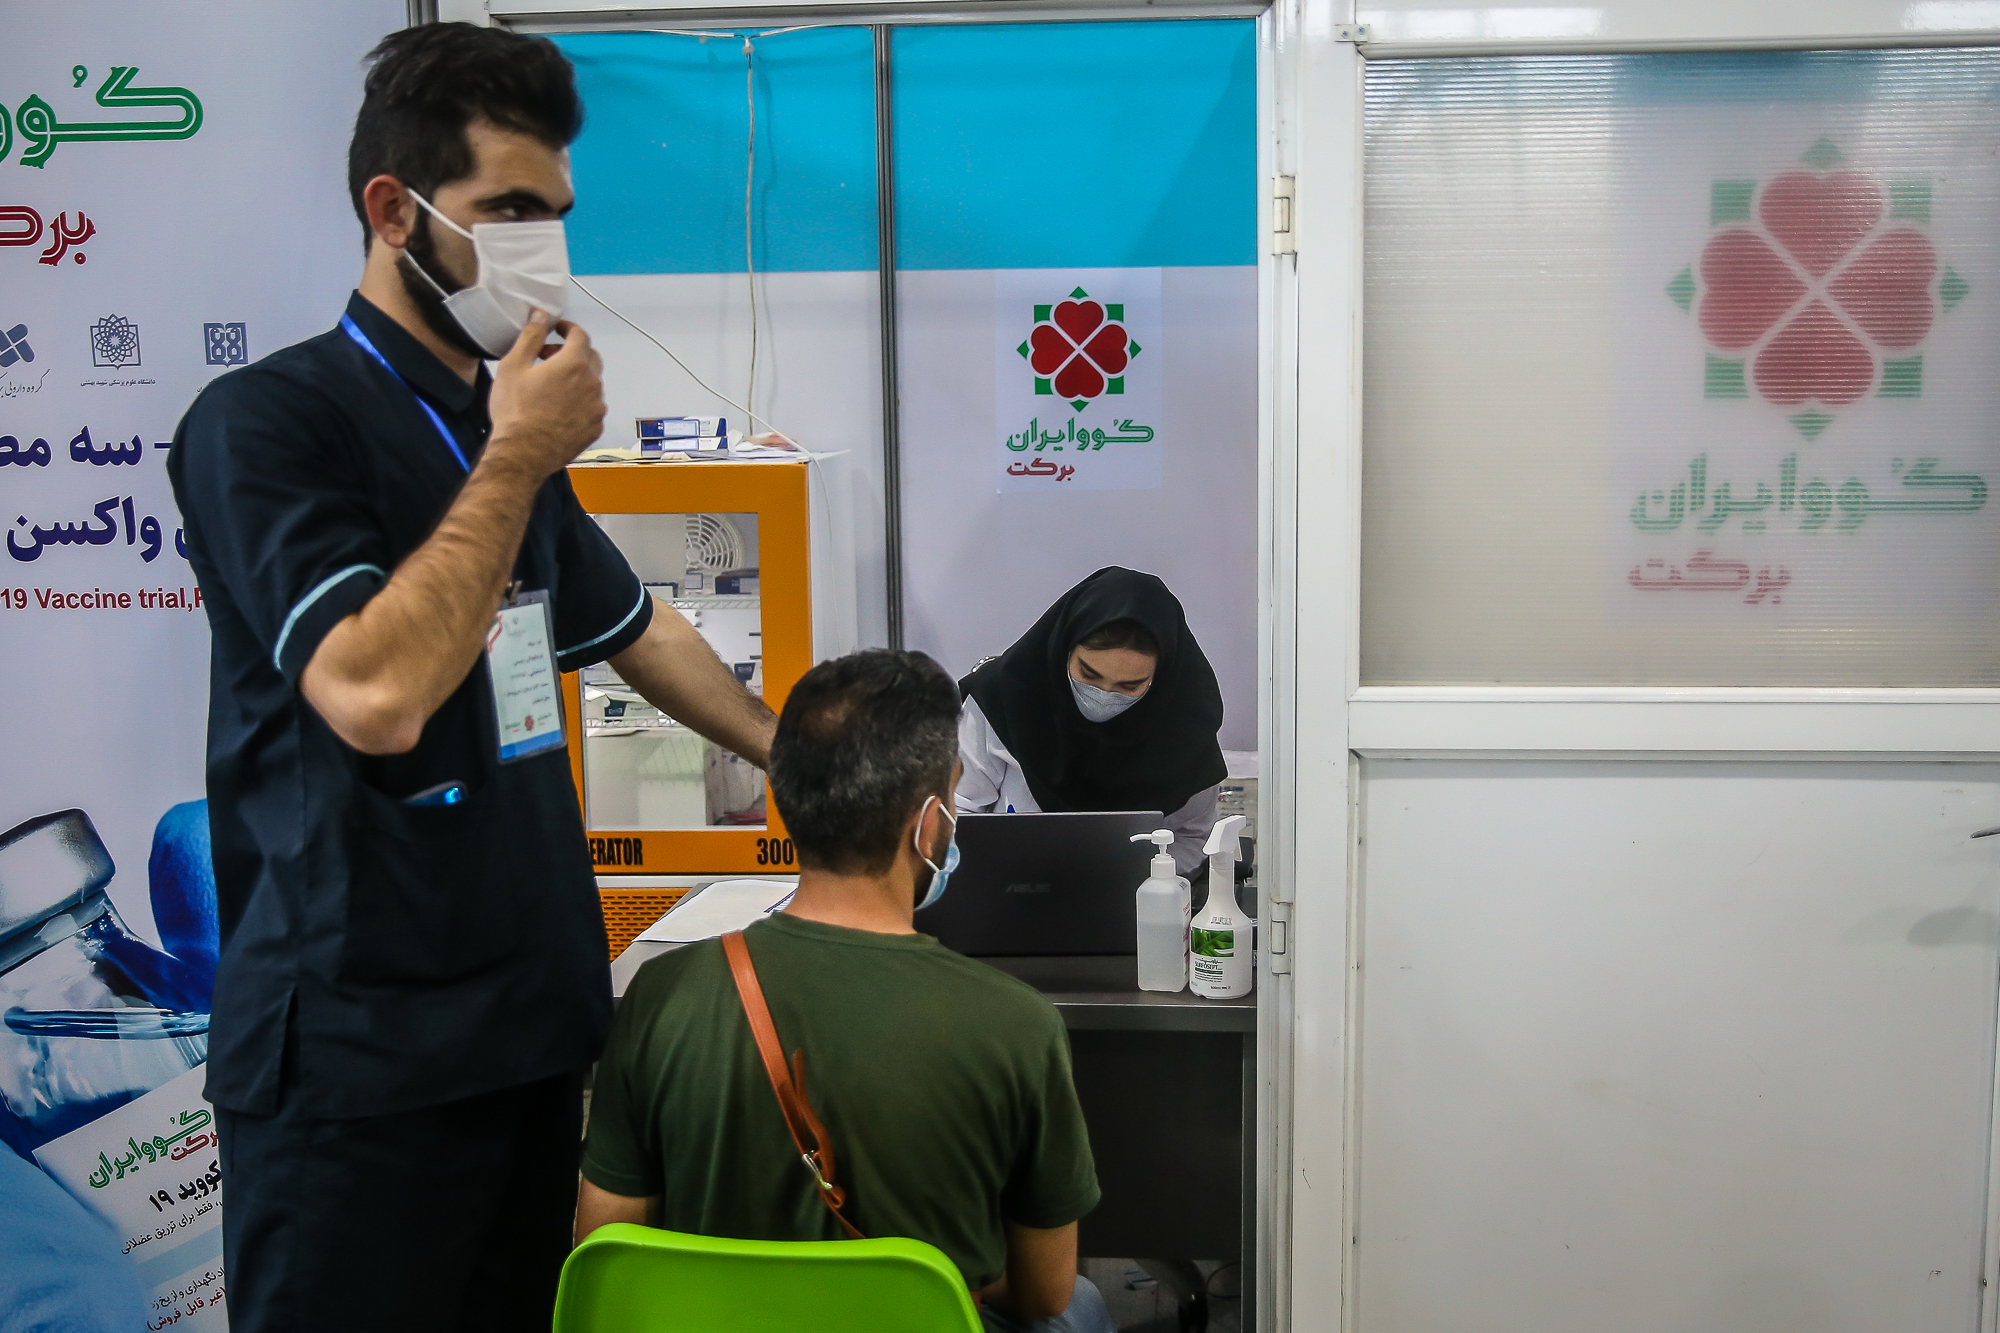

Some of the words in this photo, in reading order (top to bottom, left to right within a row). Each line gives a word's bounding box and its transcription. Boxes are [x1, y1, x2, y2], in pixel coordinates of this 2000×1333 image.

[69, 425, 142, 466] سه
[1006, 457, 1075, 481] برکت
[6, 495, 162, 564] واکسن
[1627, 547, 1792, 605] برکت
[33, 587, 132, 610] Vaccine
[590, 837, 643, 866] ERATOR
[148, 1189, 175, 1213] ۱۹
[195, 1200, 214, 1217] فقط
[154, 1220, 177, 1241] تزریق
[178, 1212, 196, 1229] برای
[120, 1234, 153, 1256] عضلانی
[185, 1296, 206, 1317] قابل
[146, 1307, 182, 1331] فروش)
